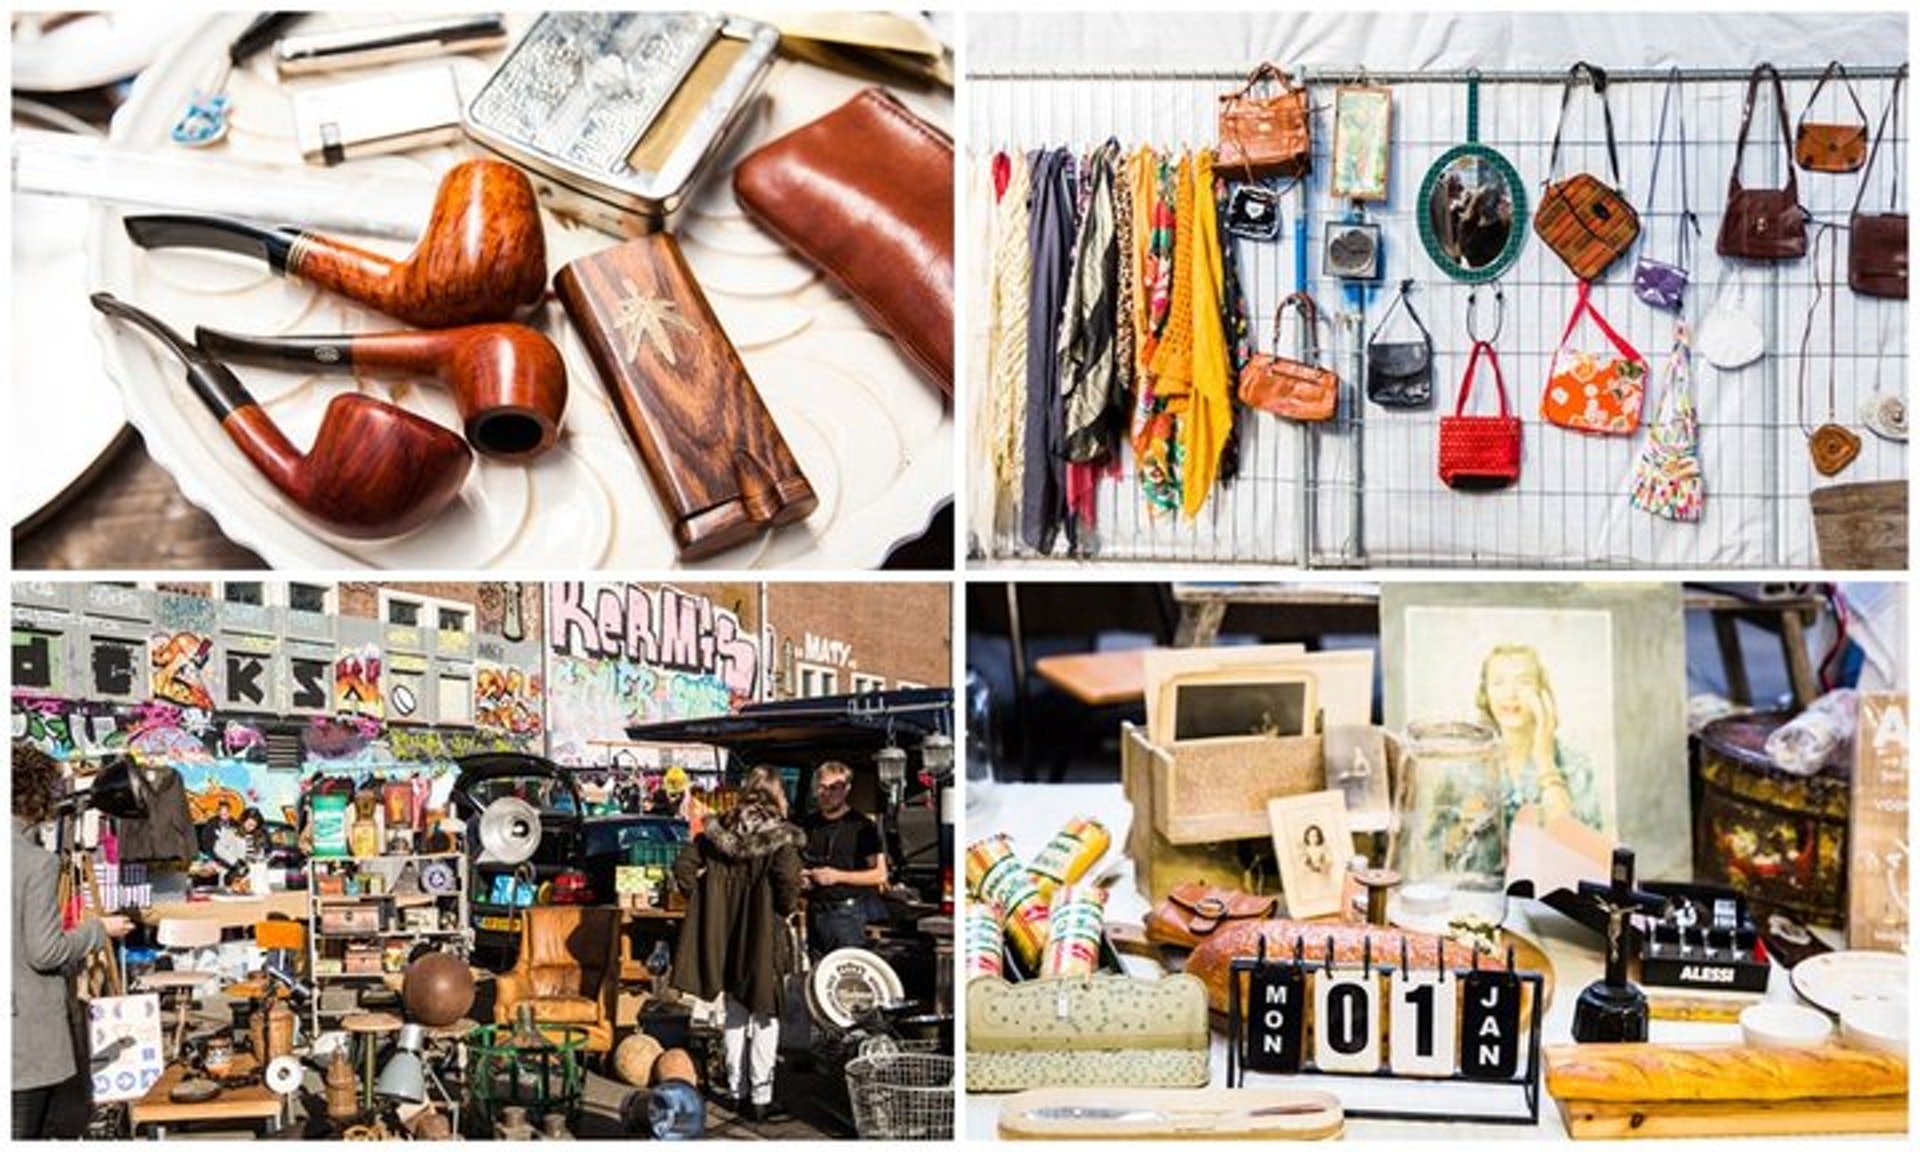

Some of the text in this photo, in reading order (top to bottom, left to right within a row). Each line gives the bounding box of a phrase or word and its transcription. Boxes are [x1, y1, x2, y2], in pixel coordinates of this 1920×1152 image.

[1680, 965, 1735, 982] ALESSI
[1263, 983, 1500, 1066] MON 01 JAN
